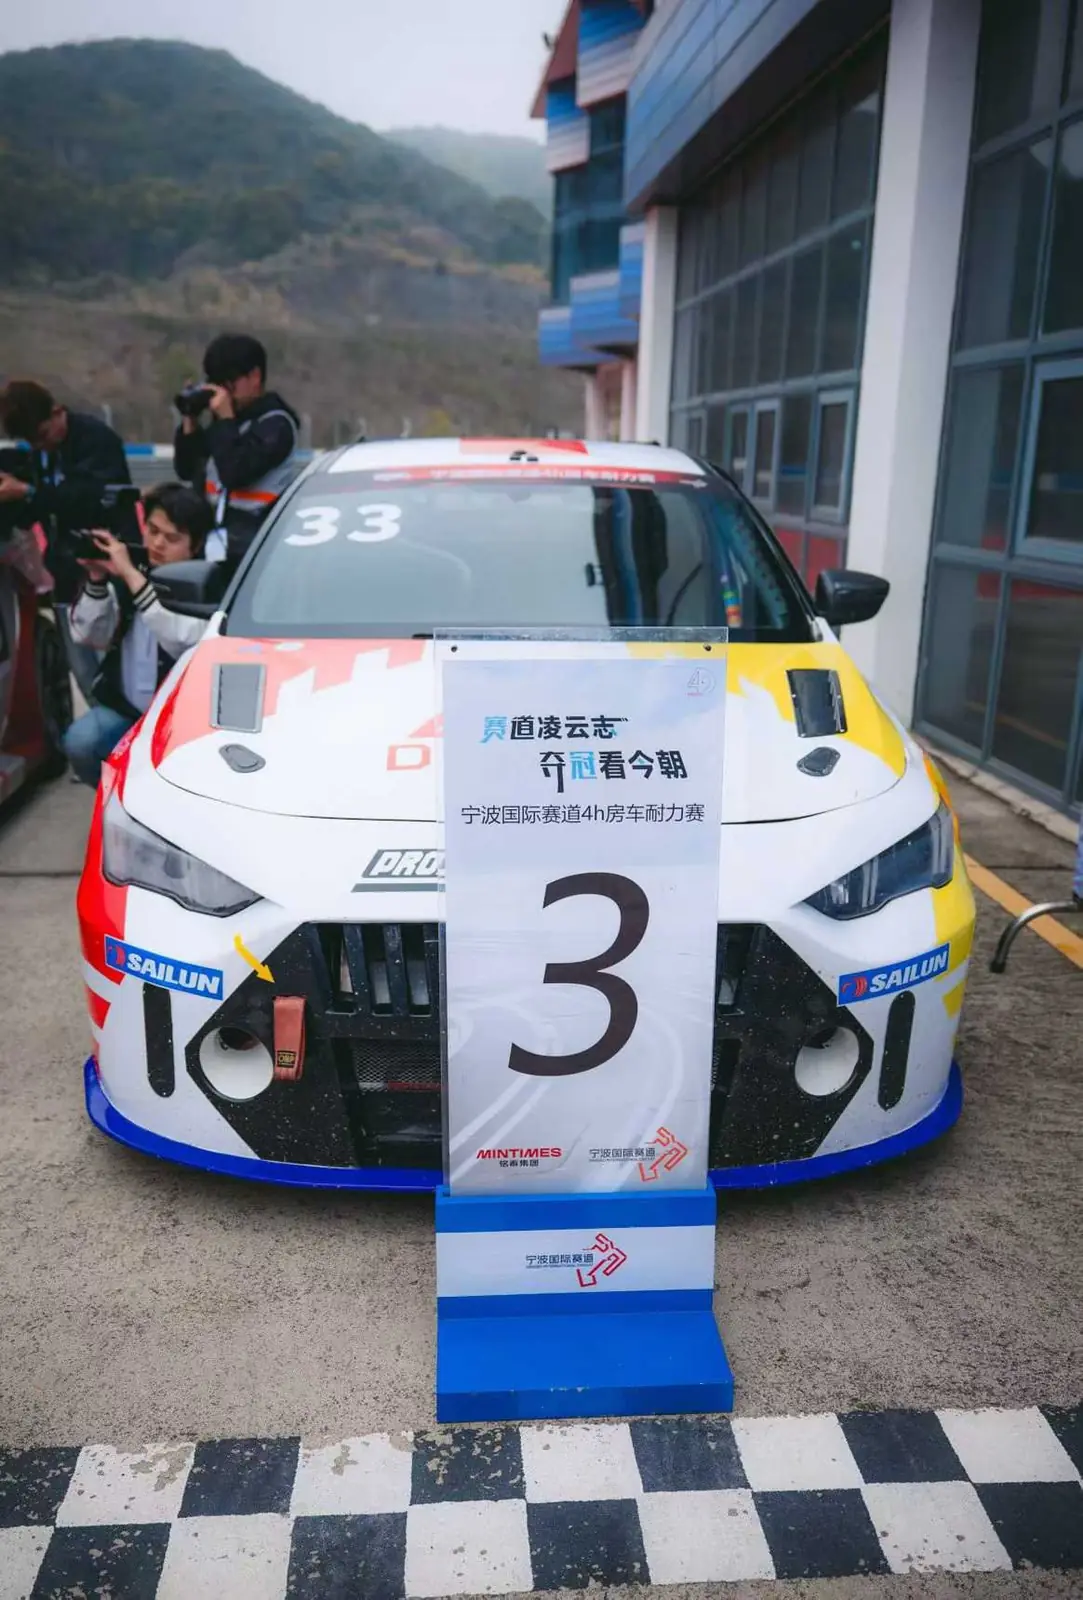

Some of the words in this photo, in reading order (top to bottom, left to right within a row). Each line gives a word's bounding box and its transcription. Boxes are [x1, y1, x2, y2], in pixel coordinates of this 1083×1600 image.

[284, 504, 402, 546] 33
[479, 714, 629, 744] 赛道凌云志
[539, 749, 688, 793] 夺冠看今朝
[460, 803, 705, 825] 宁波国际赛道4h房车耐力赛
[126, 952, 220, 995] SAILUN
[508, 872, 650, 1077] 3
[869, 950, 948, 993] SAILUN
[476, 1147, 562, 1159] MINTIMES
[589, 1147, 656, 1159] 宁波国际赛道
[525, 1253, 594, 1265] 宁波国际赛道
